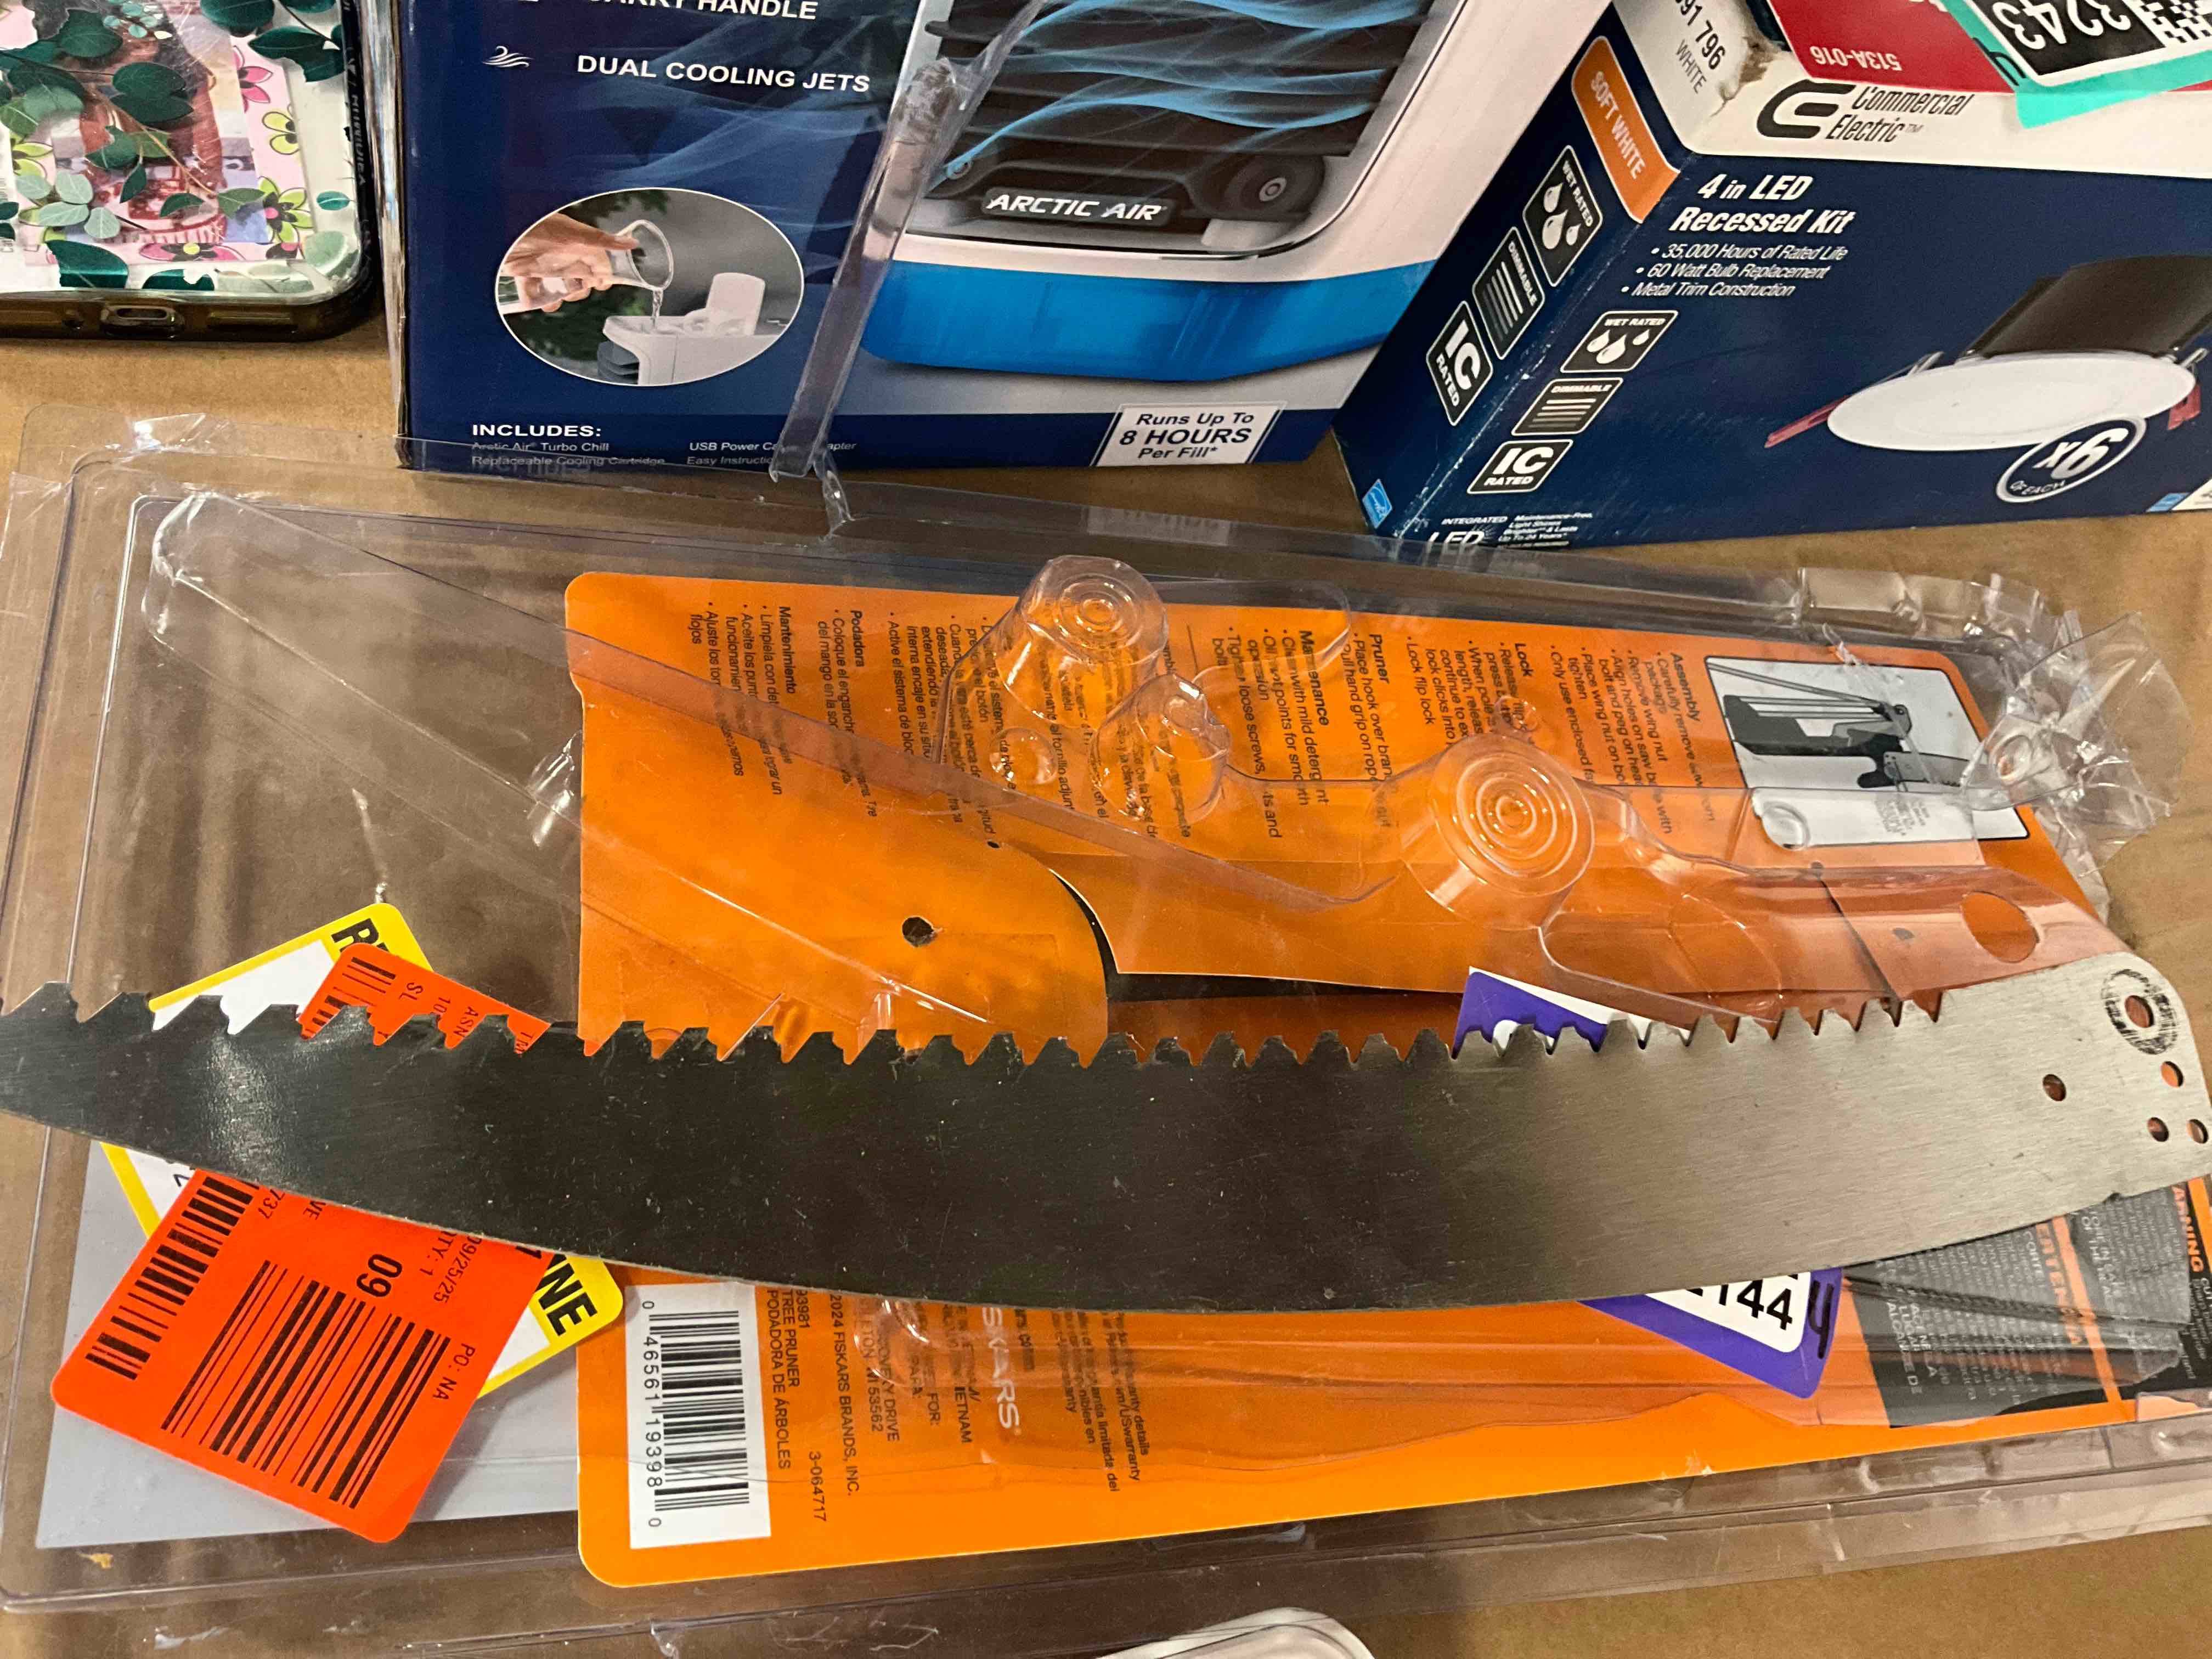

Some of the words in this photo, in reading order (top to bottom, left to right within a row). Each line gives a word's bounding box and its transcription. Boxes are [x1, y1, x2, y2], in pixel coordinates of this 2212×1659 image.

[695, 0, 818, 20] HANDLE
[1694, 20, 1726, 70] 796
[1810, 46, 1902, 72] 513A-016
[577, 55, 657, 78] DUAL
[666, 61, 795, 87] COOLING
[802, 72, 871, 93] JETS
[1675, 39, 1707, 94] WHITE
[1852, 85, 1975, 116] Commercial
[1590, 71, 1616, 121] SOFT
[1610, 116, 1646, 180] WHITE
[1562, 160, 1577, 188] WET
[1573, 185, 1593, 227] RATED
[1697, 174, 1727, 199] 4
[1720, 179, 1747, 199] in
[1749, 175, 1813, 201] LED
[986, 194, 1100, 217] ARCTIC
[1668, 207, 1813, 232] Recessed
[1807, 210, 1857, 233] Kit
[1662, 244, 1718, 260] 35,000
[1716, 245, 1758, 258] Hours
[1760, 245, 1782, 259] of
[1779, 245, 1821, 259] Rated
[1820, 246, 1848, 260] Life
[1508, 241, 1538, 307] DIMMABLE
[1647, 263, 1671, 278] 60
[1672, 263, 1707, 278] Watt
[1706, 263, 1739, 278] Bulb
[1738, 266, 1830, 280] Replacement
[1632, 282, 1672, 296] Metal
[1675, 283, 1707, 296] Trim
[1707, 282, 1795, 296] Construction
[1629, 318, 1666, 326] RATED
[1444, 319, 1481, 390] IC
[1436, 352, 1459, 407] RATED
[1551, 384, 1612, 393] DIMMABLE
[472, 424, 602, 437] INCLUDES:
[1136, 414, 1190, 426] Runs
[1197, 413, 1224, 426] Up
[1233, 412, 1254, 424] To
[540, 443, 578, 452] Turbo
[582, 443, 610, 452] Chill
[690, 442, 717, 451] USB
[721, 442, 760, 451] Power
[1119, 430, 1138, 445] 8
[1144, 428, 1252, 445] HOURS
[472, 456, 552, 466] Replaceable
[556, 456, 604, 466] Cooling
[687, 456, 716, 466] Easy
[1137, 448, 1173, 459] Per
[1493, 447, 1554, 475] IC
[1484, 476, 1534, 486] RATED
[1441, 516, 1508, 525] INTEGRATED
[688, 614, 703, 645] flojos
[703, 611, 718, 646] Ajuste
[741, 613, 755, 650] Aceite
[818, 621, 831, 639] del
[833, 618, 846, 667] Coloque
[850, 610, 866, 667] Podadora
[888, 621, 901, 656] Active
[708, 649, 721, 665] los
[779, 606, 797, 694] Mantenimiento
[906, 625, 919, 664] interna
[1369, 634, 1390, 684] Pruner
[1407, 644, 1423, 673] Lock
[1515, 643, 1534, 676] Lock
[745, 653, 757, 668] los
[765, 664, 776, 685] con
[819, 641, 832, 681] mango
[838, 669, 849, 679] el
[893, 658, 904, 667] el
[921, 626, 940, 697] extendiendo
[1426, 649, 1441, 674] lock
[1469, 647, 1484, 684] When
[1483, 652, 1503, 687] press
[1598, 659, 1615, 682] bolt
[824, 684, 834, 697] en
[894, 670, 907, 713] sistema
[912, 666, 926, 703] encaje
[1345, 669, 1363, 702] hand
[1353, 640, 1369, 674] Place
[1361, 678, 1379, 710] hook
[1370, 713, 1385, 742] over
[1414, 676, 1427, 696] flip
[1432, 678, 1448, 713] clicks
[1440, 649, 1461, 703] continue
[1454, 707, 1464, 720] to
[1606, 685, 1622, 708] and
[1671, 652, 1701, 722] Assembly
[826, 699, 837, 709] la
[917, 705, 927, 720] en
[1271, 687, 1291, 729] points
[1284, 733, 1296, 751] for
[1350, 704, 1368, 730] grip
[1420, 698, 1436, 725] lock
[1550, 651, 1566, 680] Only
[1559, 682, 1571, 704] use
[1566, 707, 1593, 765] enclosed
[1581, 653, 1598, 687] Place
[1591, 690, 1607, 720] wing
[1601, 723, 1615, 743] nut
[1608, 745, 1620, 762] on
[1621, 689, 1638, 722] holes
[899, 715, 912, 730] de
[1297, 706, 1314, 734] mild
[1442, 715, 1455, 740] into
[1611, 710, 1628, 736] peg
[1632, 724, 1644, 740] on
[1644, 709, 1660, 738] wing
[1654, 741, 1668, 761] nut
[1360, 733, 1372, 751] on
[1622, 738, 1634, 754] on
[1674, 714, 1695, 759] remove
[1239, 685, 1255, 721] loose
[1265, 810, 1283, 838] and
[1637, 743, 1652, 769] saw
[356, 1254, 403, 1297] 09
[781, 1290, 795, 1325] TREE
[830, 1294, 844, 1328] 2024
[768, 1290, 783, 1369] PODADORA
[448, 1343, 475, 1371] PO:
[644, 1336, 660, 1402] 46561
[785, 1329, 800, 1387] PRUNER
[833, 1331, 850, 1392] FISKARS
[433, 1377, 457, 1400] NA
[772, 1374, 785, 1393] DE
[774, 1397, 791, 1469] ÁRBOLES
[839, 1395, 857, 1462] BRANDS,
[883, 1398, 900, 1442] DRIVE
[1134, 1415, 1150, 1455] details
[645, 1418, 663, 1488] 19398
[809, 1451, 827, 1522] 3-064717
[845, 1465, 860, 1497] INC.
[1107, 1472, 1120, 1492] del
[648, 1518, 662, 1528] 0
